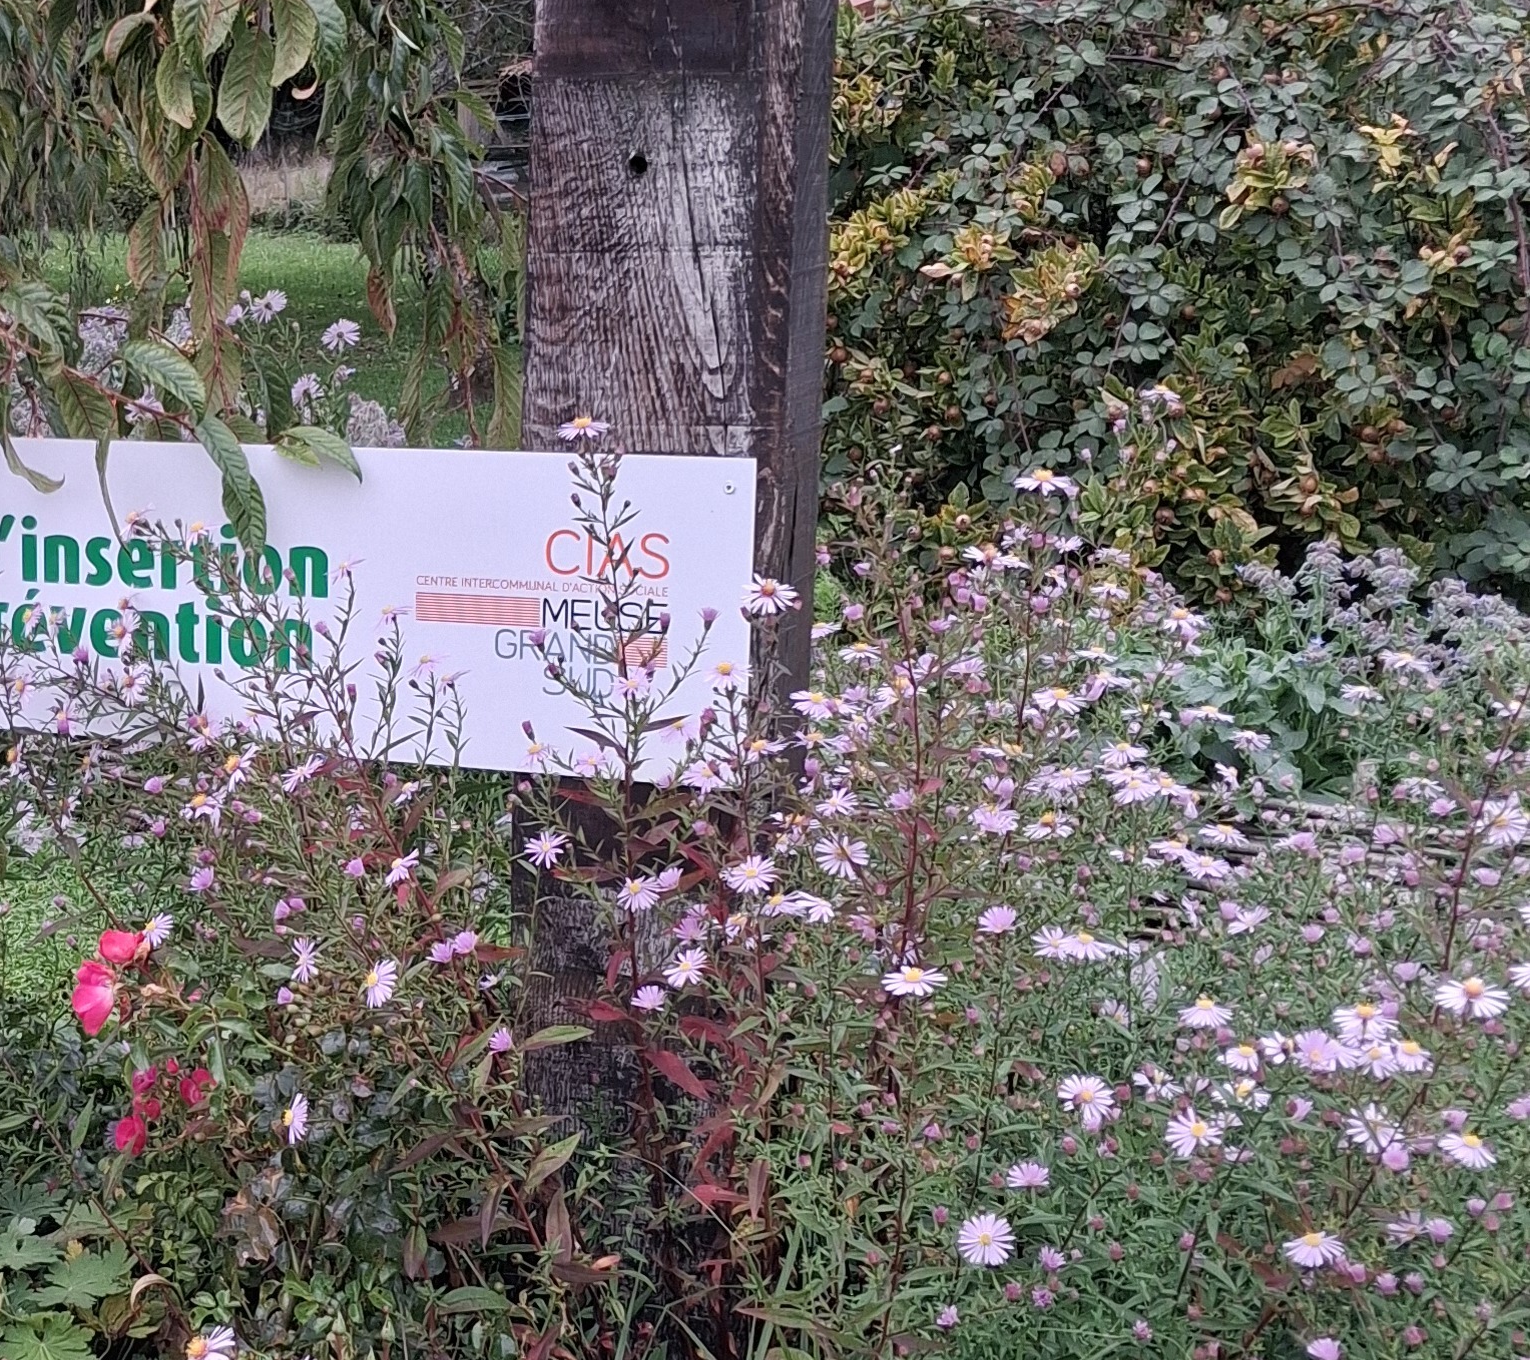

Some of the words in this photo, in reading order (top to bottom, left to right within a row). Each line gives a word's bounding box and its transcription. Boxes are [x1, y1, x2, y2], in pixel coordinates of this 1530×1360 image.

[545, 529, 670, 579] CIAS
[416, 575, 458, 587] CENTRE
[461, 577, 559, 592] INTERCOMMUNAL
[618, 584, 669, 597] SCIALE
[542, 597, 669, 635] MEUSE
[494, 628, 615, 665] GRAND
[542, 666, 615, 700] SUD
